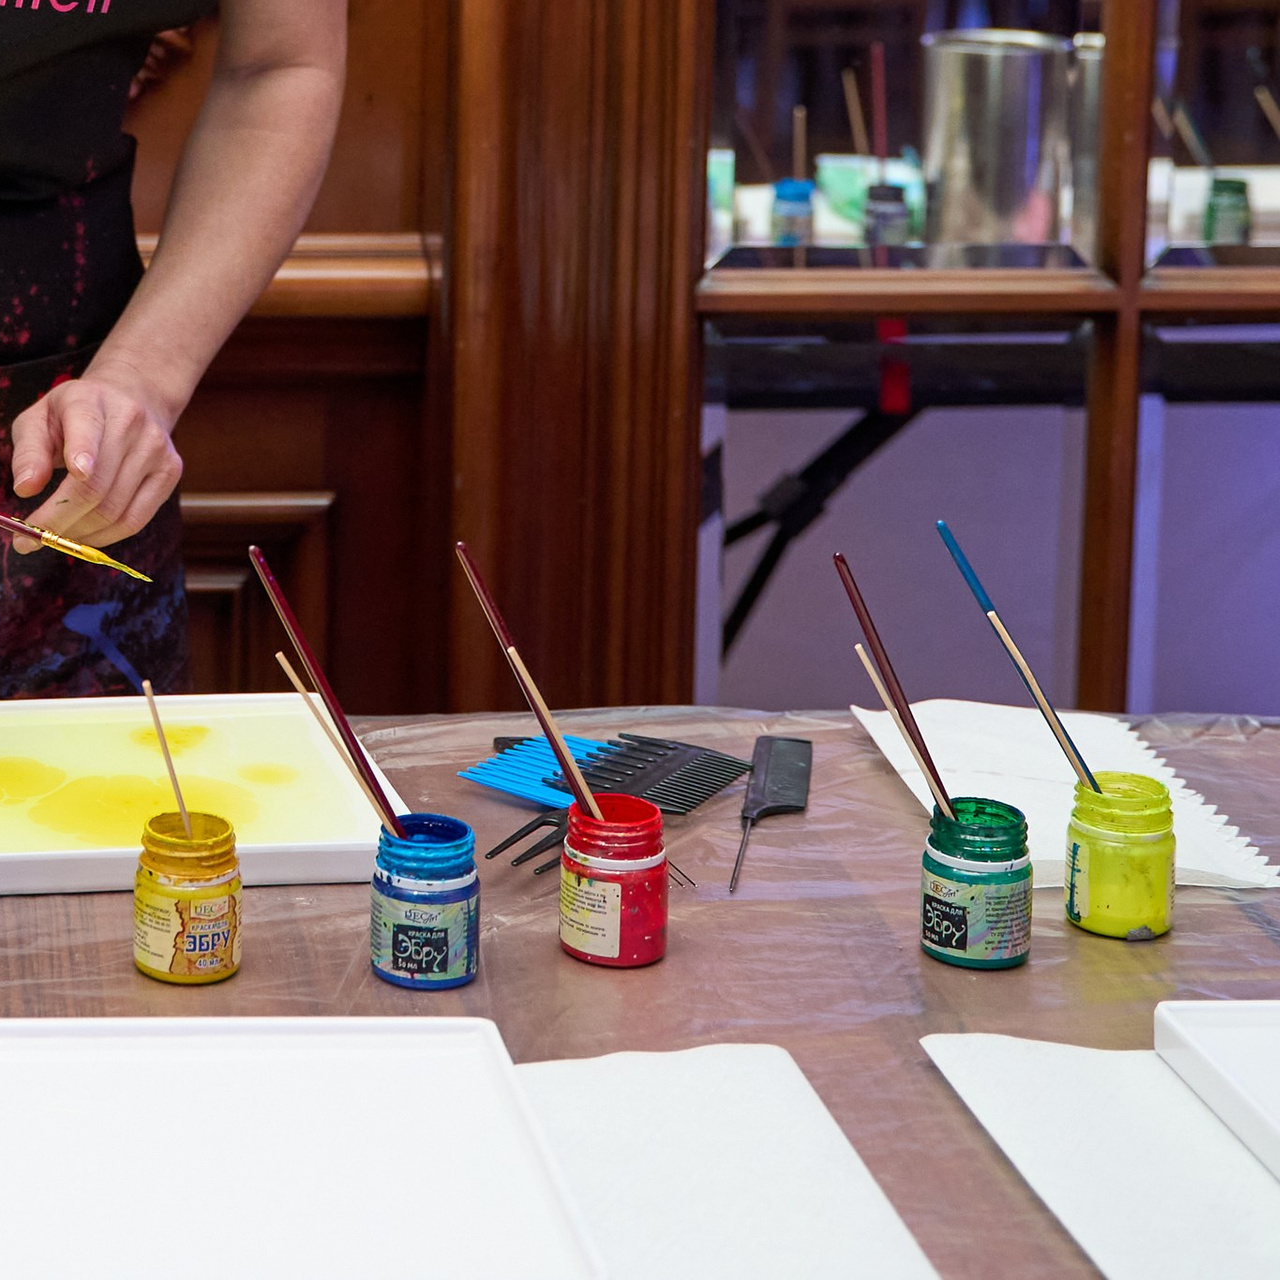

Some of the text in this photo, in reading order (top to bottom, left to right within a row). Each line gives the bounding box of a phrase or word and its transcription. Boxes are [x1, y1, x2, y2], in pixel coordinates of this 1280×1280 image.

[932, 901, 963, 916] КРАСКА ДЛЯ
[185, 929, 231, 953] ЭБРУ
[407, 930, 445, 939] КРАСКА ДЛЯ
